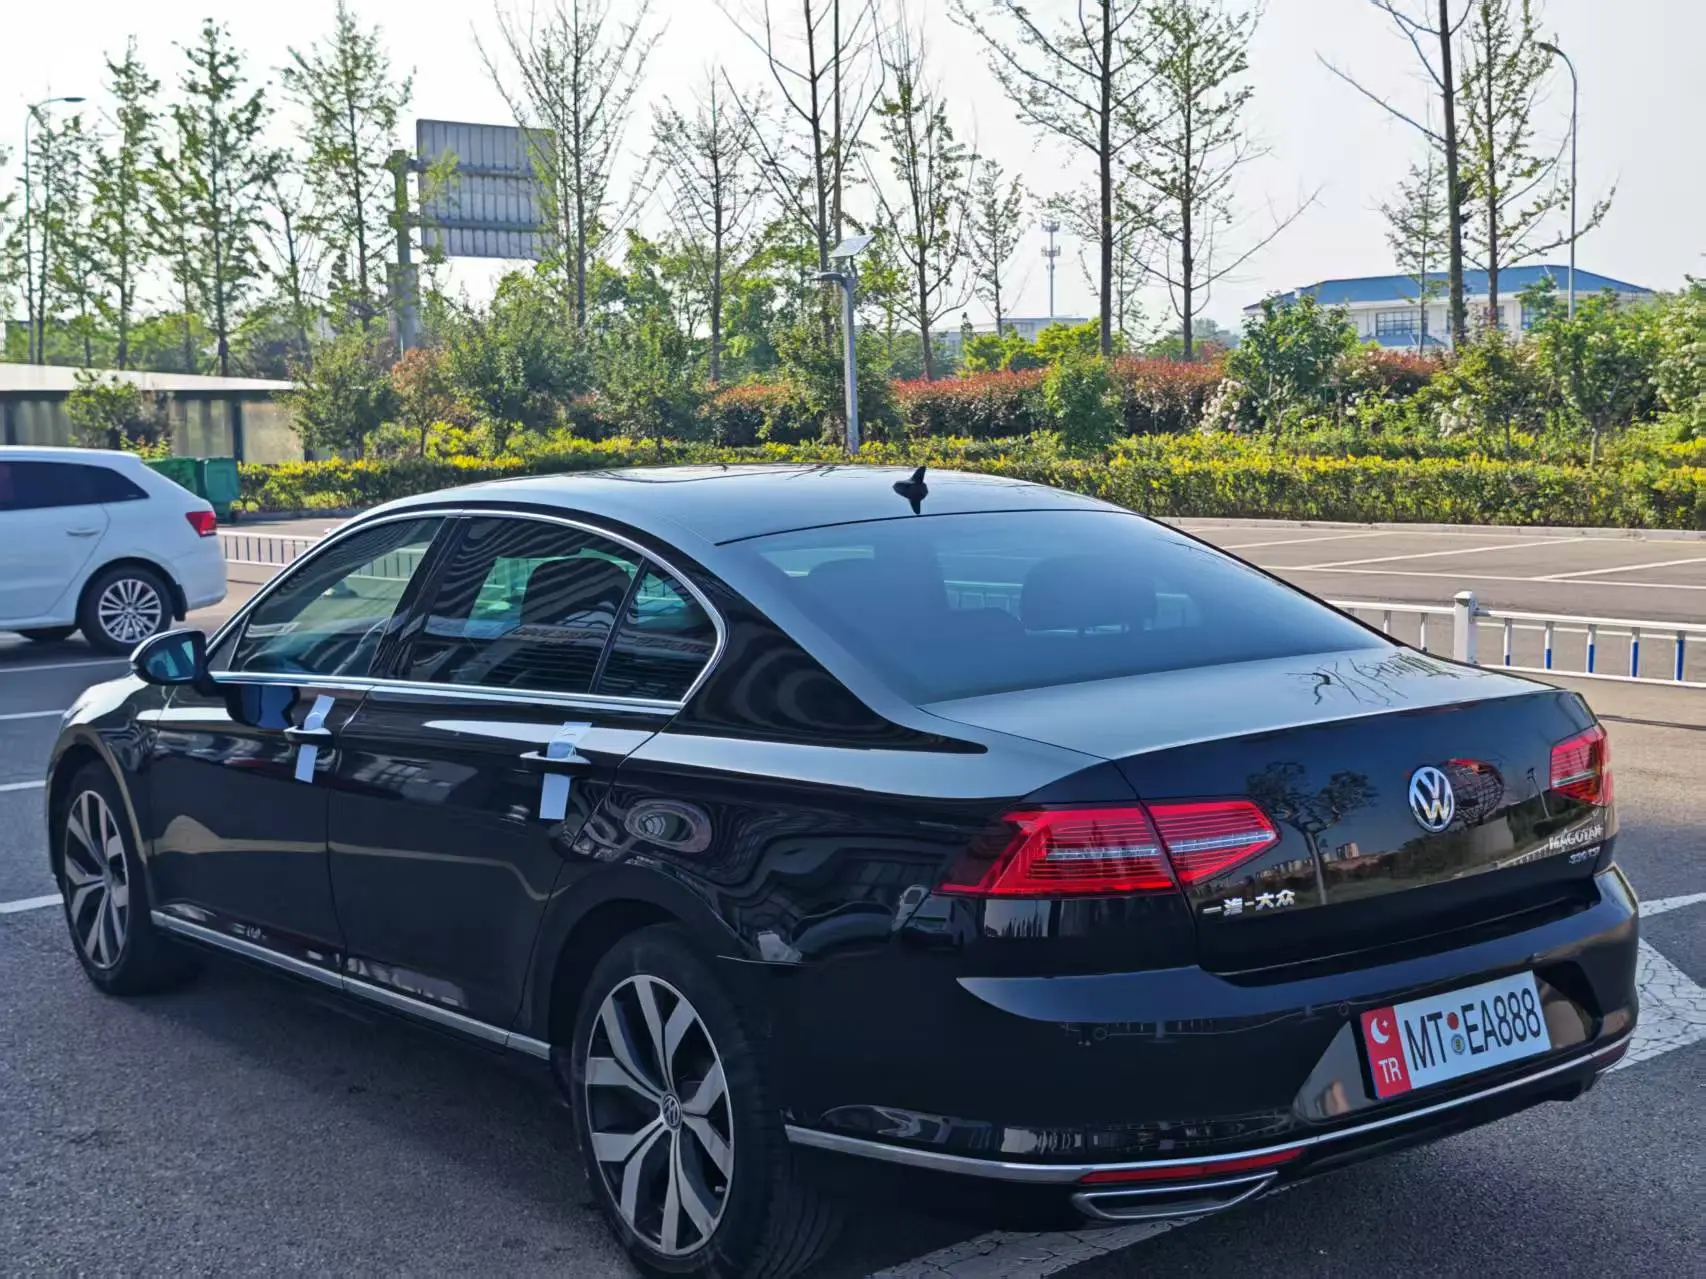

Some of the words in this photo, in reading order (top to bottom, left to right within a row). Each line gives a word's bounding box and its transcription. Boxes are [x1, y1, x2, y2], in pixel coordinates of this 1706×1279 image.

[1404, 1011, 1447, 1071] MT
[1460, 987, 1541, 1055] EA888
[1378, 1056, 1402, 1084] TR
